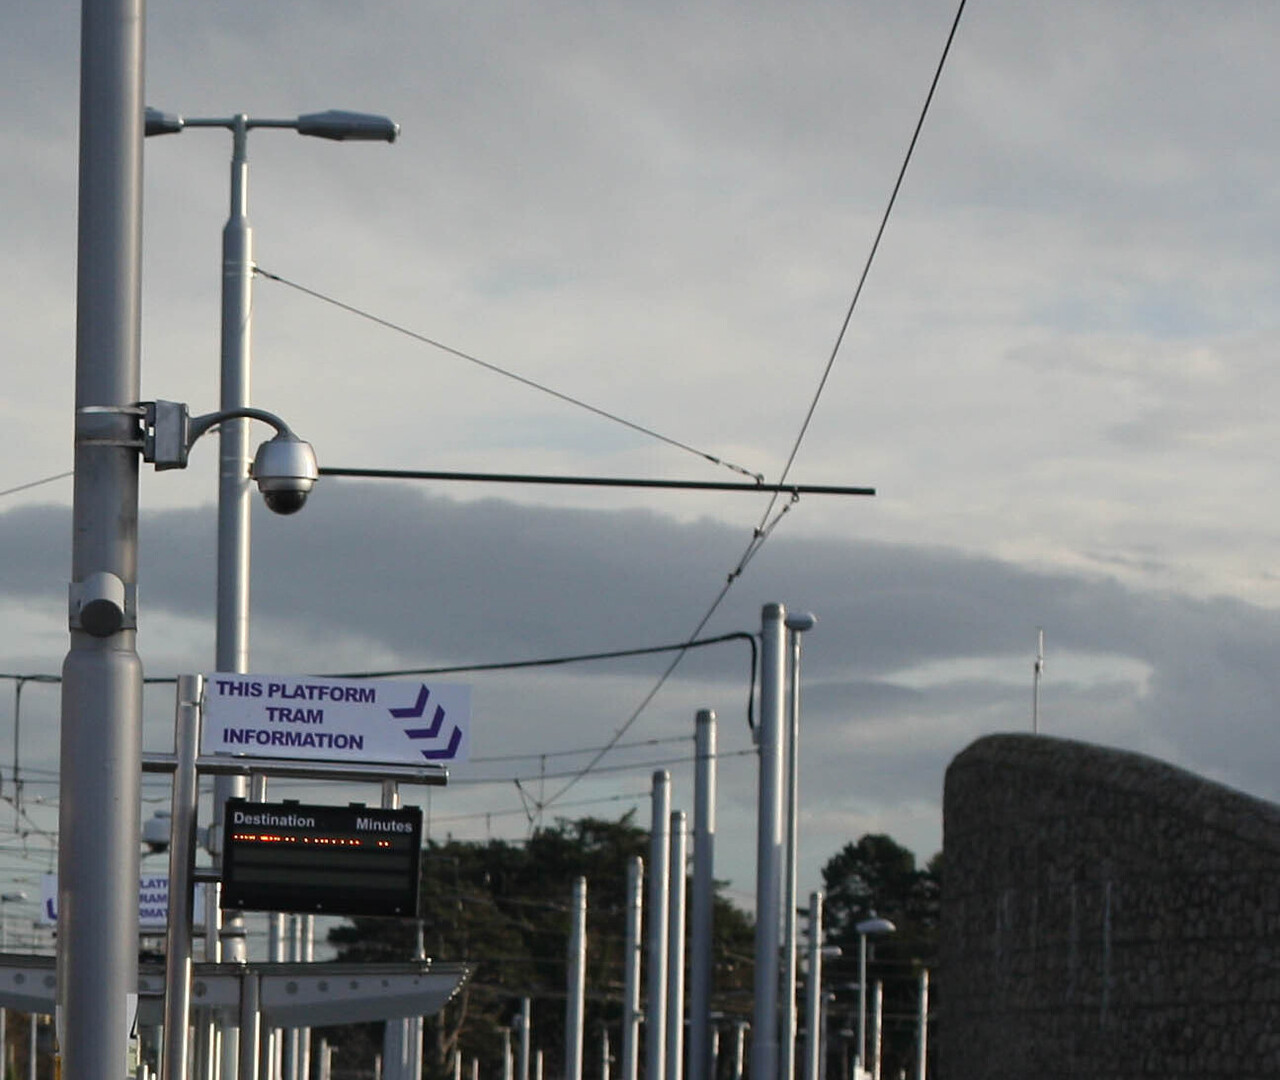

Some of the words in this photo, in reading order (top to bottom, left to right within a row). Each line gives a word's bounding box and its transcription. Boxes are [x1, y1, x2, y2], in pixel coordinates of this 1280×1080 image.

[216, 680, 263, 698] THIS
[268, 683, 376, 704] PLATFORM
[266, 706, 324, 724] TRAM
[223, 728, 364, 750] INFORMATION
[233, 811, 316, 828] Destination
[355, 817, 413, 833] Minutes
